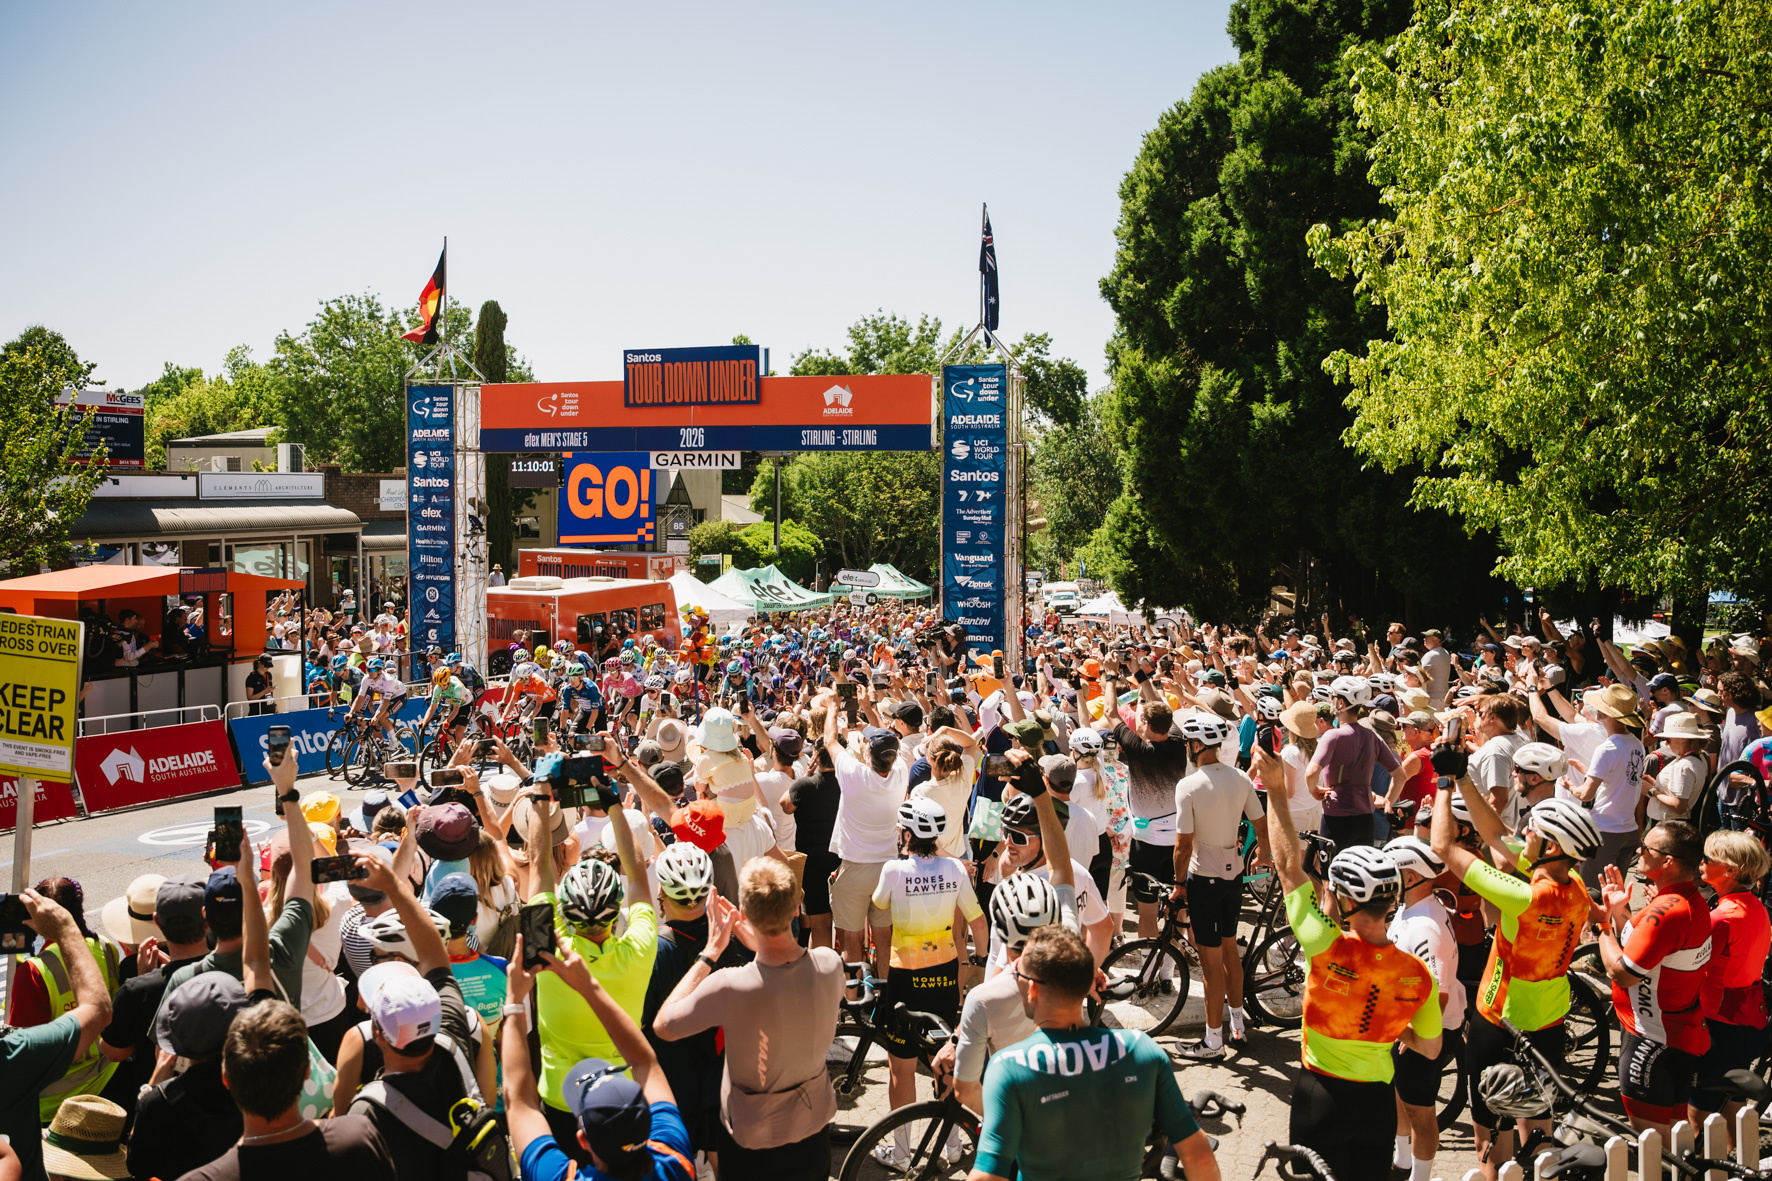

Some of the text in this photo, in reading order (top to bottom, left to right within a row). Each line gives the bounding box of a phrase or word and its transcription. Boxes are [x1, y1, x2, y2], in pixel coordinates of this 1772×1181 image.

[626, 353, 662, 363] Santos
[626, 359, 757, 404] TOUR DOWN UNDER
[106, 393, 141, 404] McGEES
[103, 416, 129, 424] STIRLING
[950, 415, 1000, 424] ADELAIDE
[412, 429, 449, 437] ADELAIDE
[680, 428, 705, 448] 2026
[801, 430, 835, 445] STIRLING
[842, 429, 877, 445] STIRLING
[524, 431, 588, 448] efex MEN'S STAGE 5
[655, 453, 735, 467] GARMIN
[511, 461, 555, 472] 11:10:01
[950, 469, 999, 482] Santos
[413, 476, 449, 487] Santos
[567, 462, 651, 520] GO!
[421, 507, 442, 518] efex
[420, 554, 443, 564] Hilton
[537, 554, 563, 563] Santos
[954, 553, 994, 563] Vanguard
[957, 616, 991, 626] Santini
[0, 620, 77, 641] EDESTRIAN
[0, 635, 77, 657] ROSS OVER
[26, 751, 52, 760] VAPE-FREE
[34, 747, 66, 756] SMOKE-FREE
[149, 750, 216, 774] ADELAIDE
[151, 764, 218, 782] SOUTH AUSTRALIA
[905, 875, 944, 885] HONES
[905, 881, 957, 893] LAWYERS
[913, 979, 957, 988] LAWYERS
[477, 1001, 498, 1011] Bupa
[758, 1029, 769, 1088] MAAP
